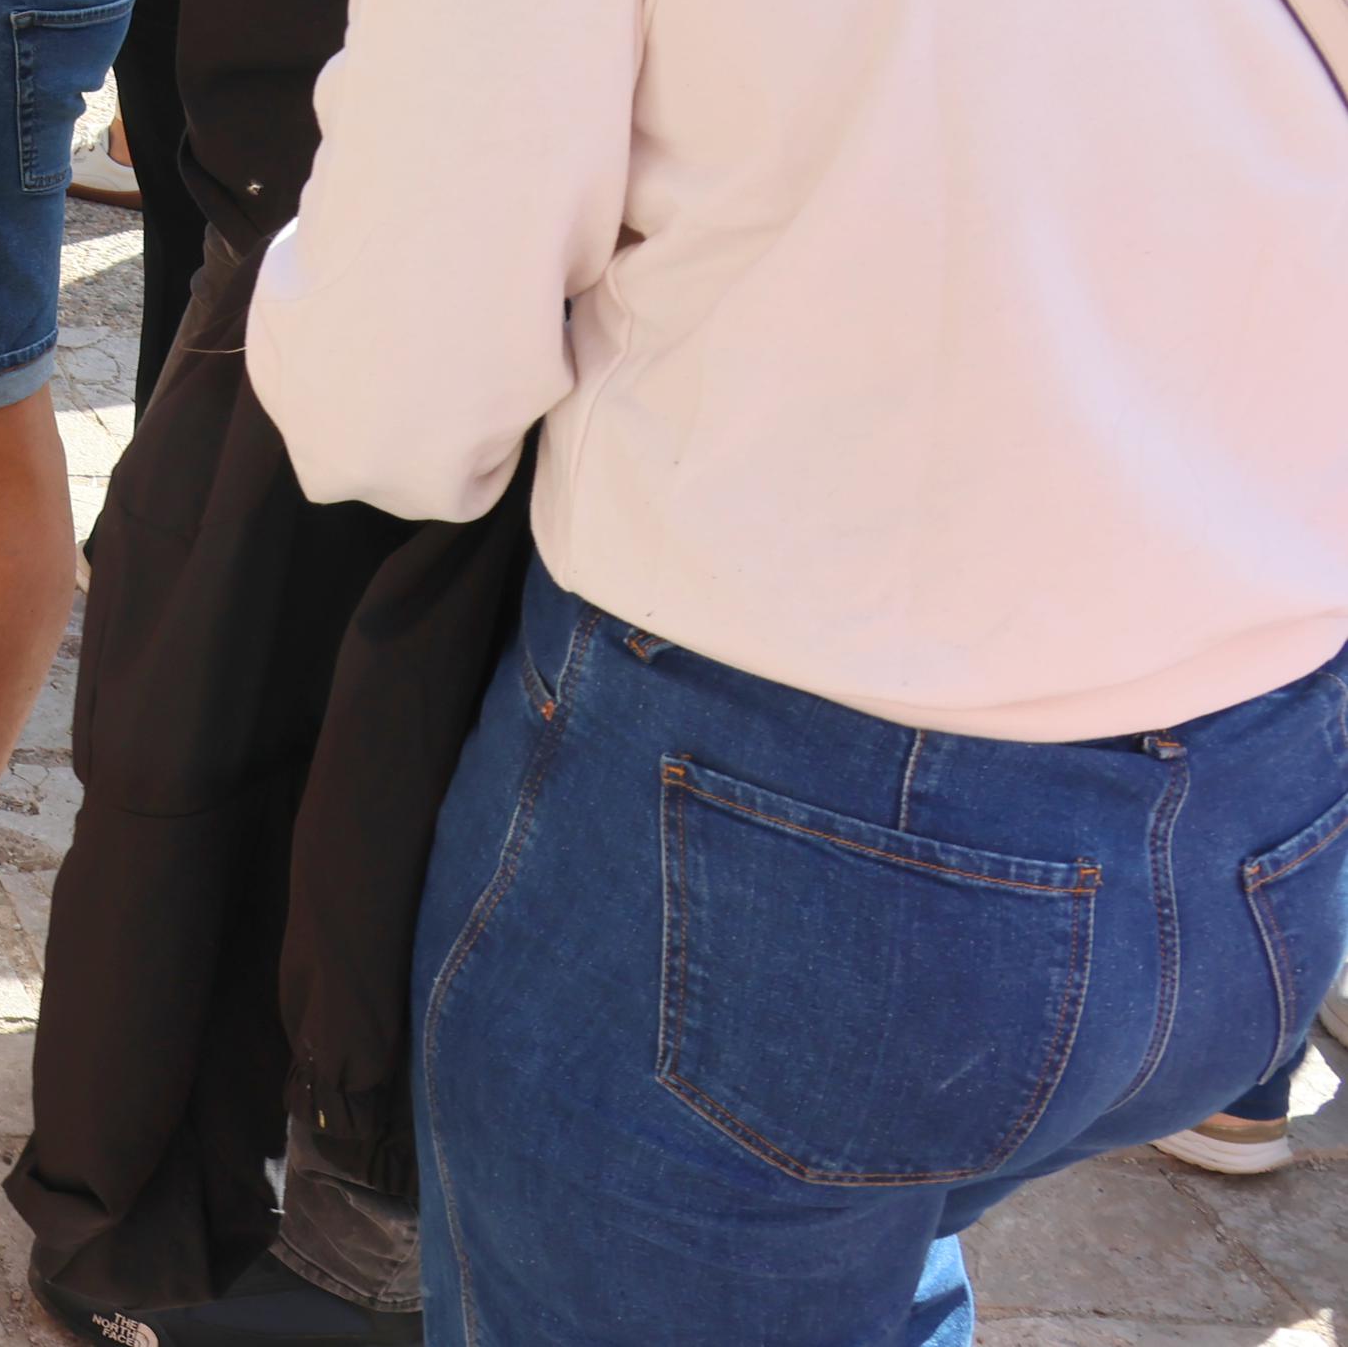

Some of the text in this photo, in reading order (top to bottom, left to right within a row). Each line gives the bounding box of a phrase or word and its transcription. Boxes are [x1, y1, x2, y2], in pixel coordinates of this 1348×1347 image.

[92, 1313, 137, 1339] NORTH
[114, 1312, 139, 1331] THE
[102, 1327, 136, 1347] FACE
